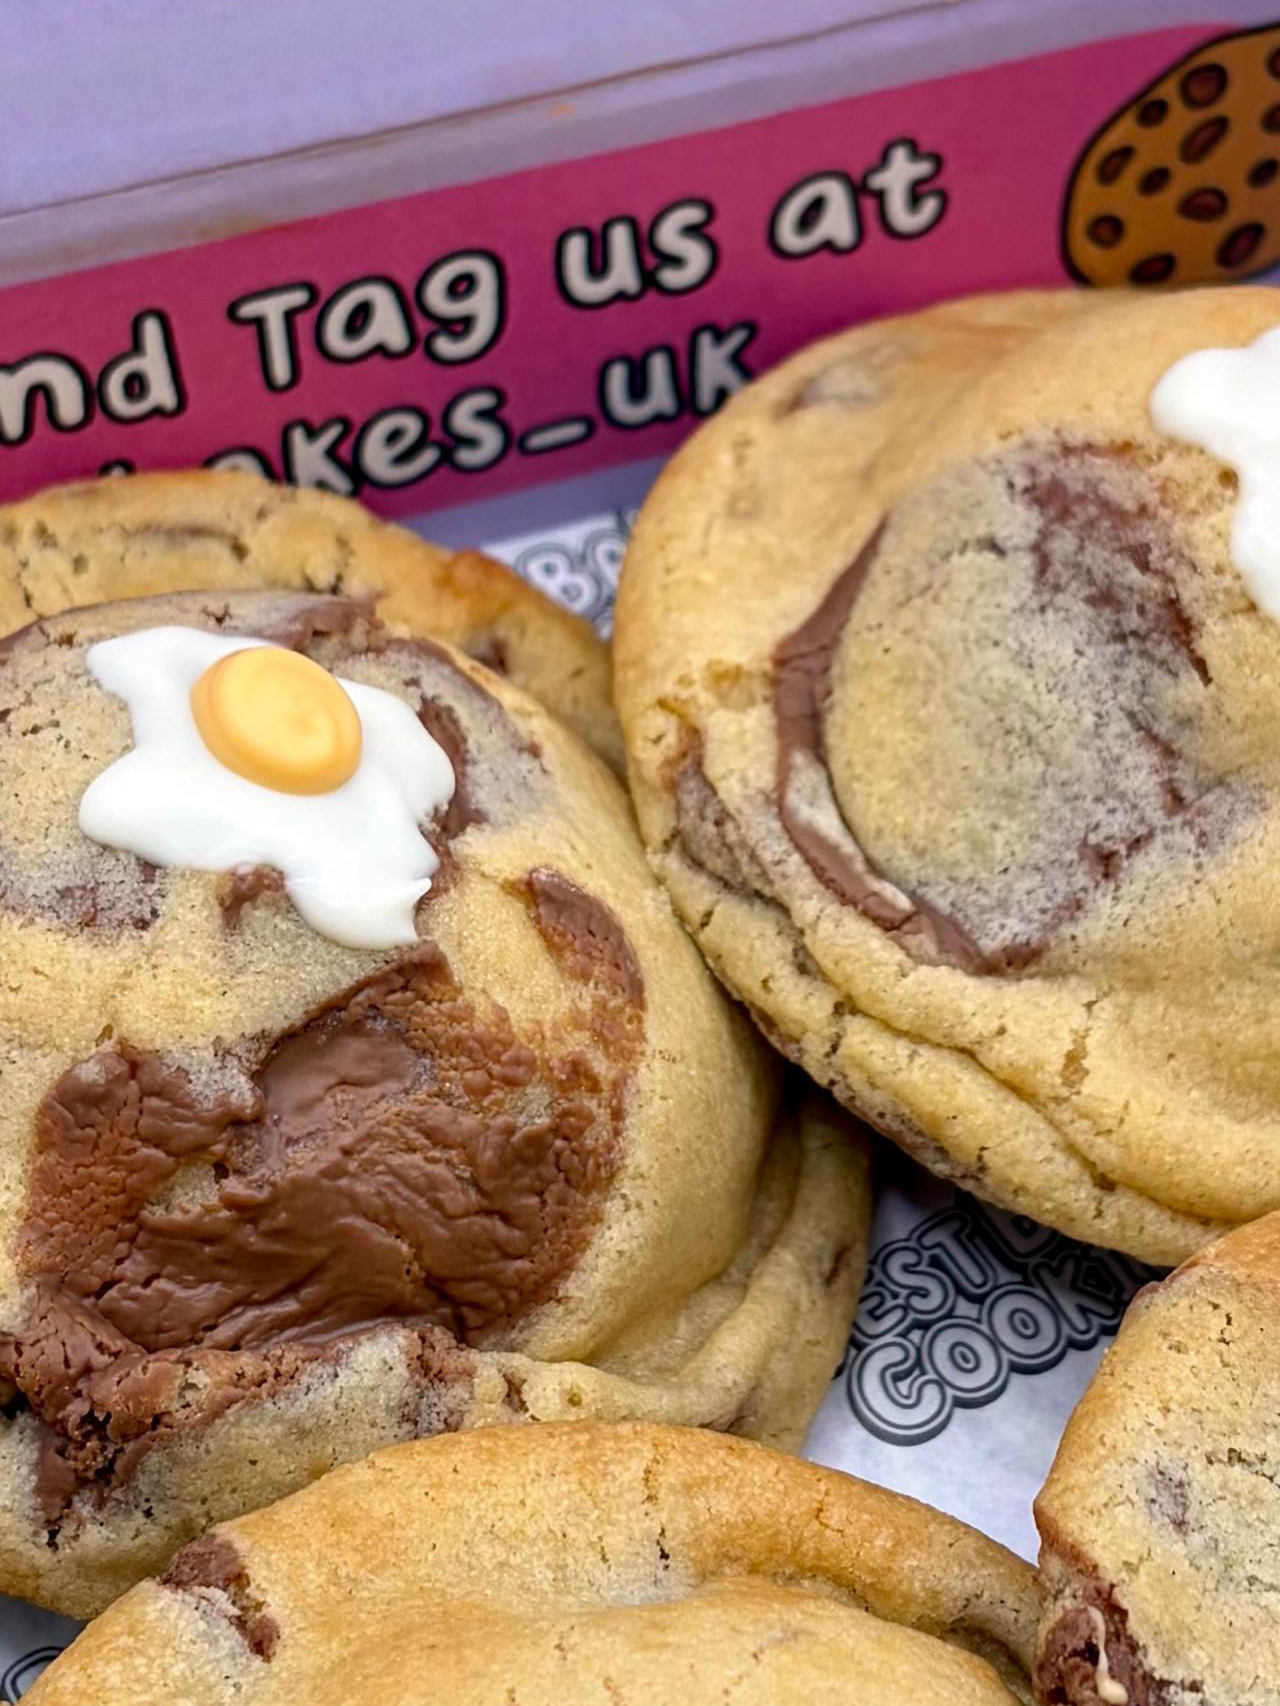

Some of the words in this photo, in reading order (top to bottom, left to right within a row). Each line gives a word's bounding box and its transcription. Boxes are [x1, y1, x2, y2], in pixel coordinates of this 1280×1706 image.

[231, 249, 507, 392] Tag
[557, 198, 718, 307] us
[769, 138, 946, 260] at
